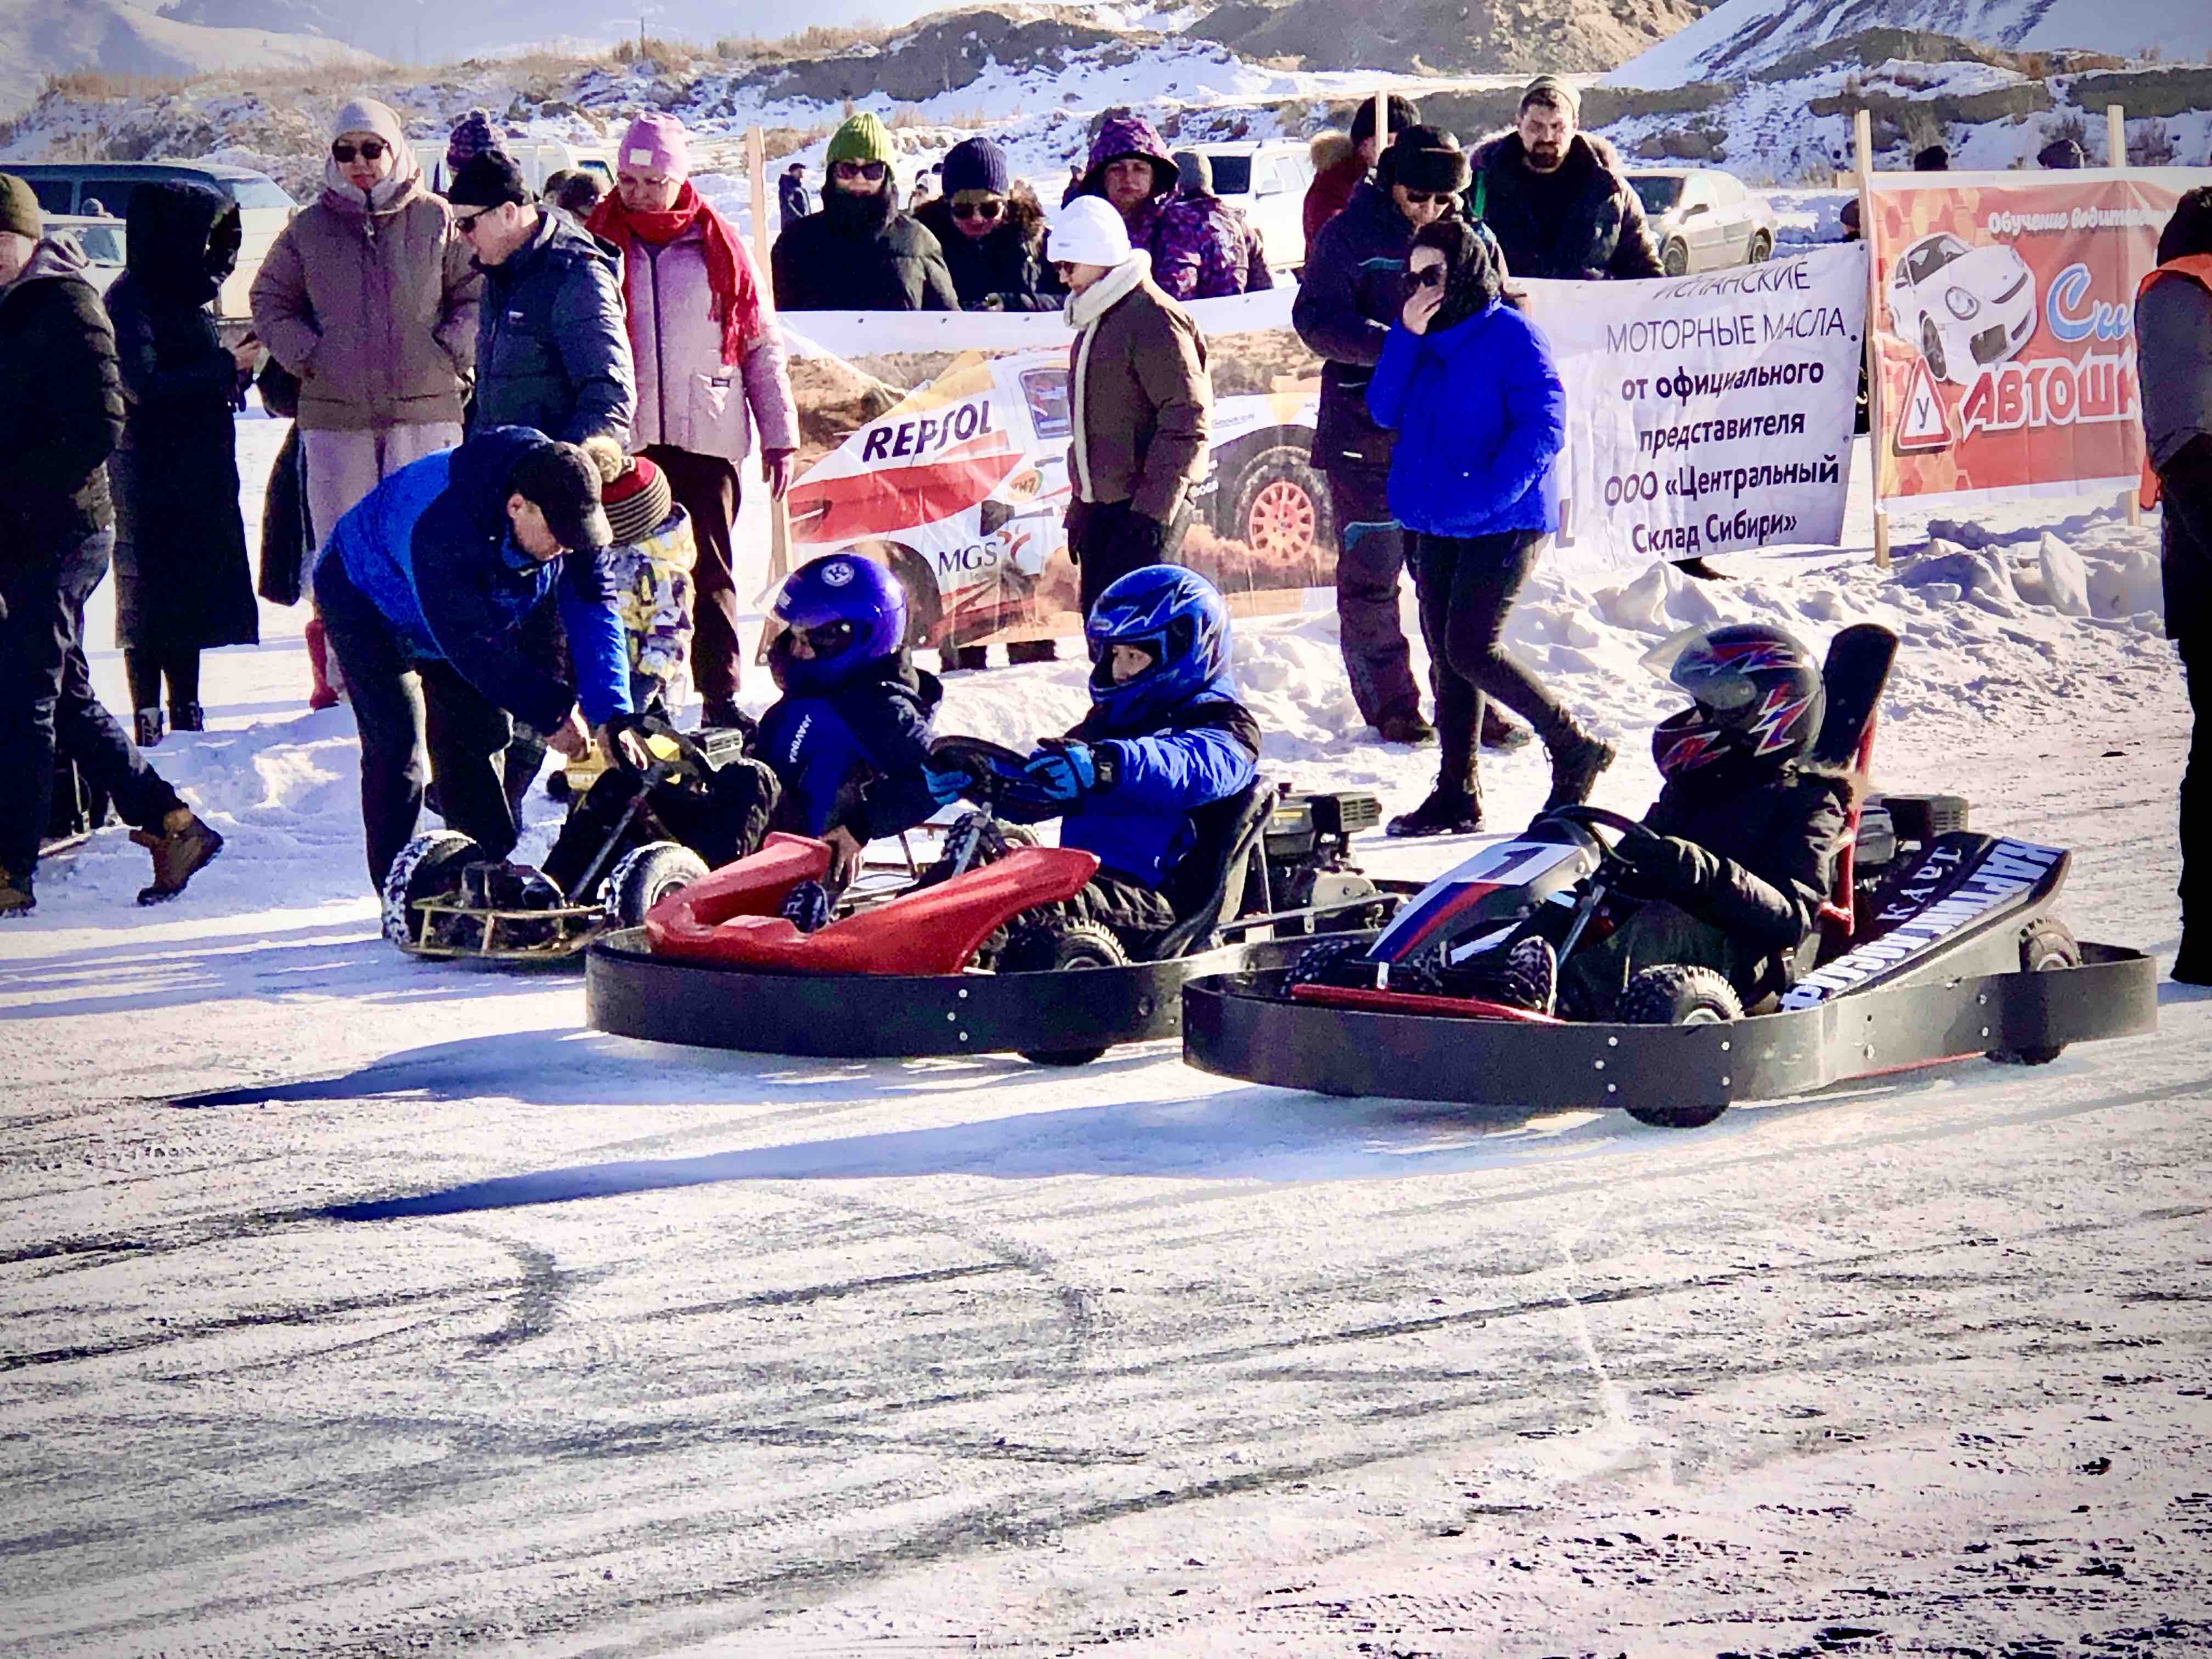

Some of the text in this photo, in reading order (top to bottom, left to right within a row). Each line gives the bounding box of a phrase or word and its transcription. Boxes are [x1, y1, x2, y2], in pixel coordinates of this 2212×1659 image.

[1988, 210, 2068, 237] Обучение
[1652, 261, 1810, 300] ИСПАНСКИЕ
[1606, 307, 1846, 354] МОТОРНЫЕ МАСЛА
[1621, 362, 1824, 407] от официального
[862, 400, 992, 462] REPSOL
[1640, 413, 1806, 459] представителя
[1604, 454, 1839, 507] ООО «Центральный
[1632, 508, 1797, 554] Склад Сибири»
[938, 541, 998, 577] MGS
[1477, 846, 1548, 879] 1
[1876, 845, 1962, 922] КАРТ
